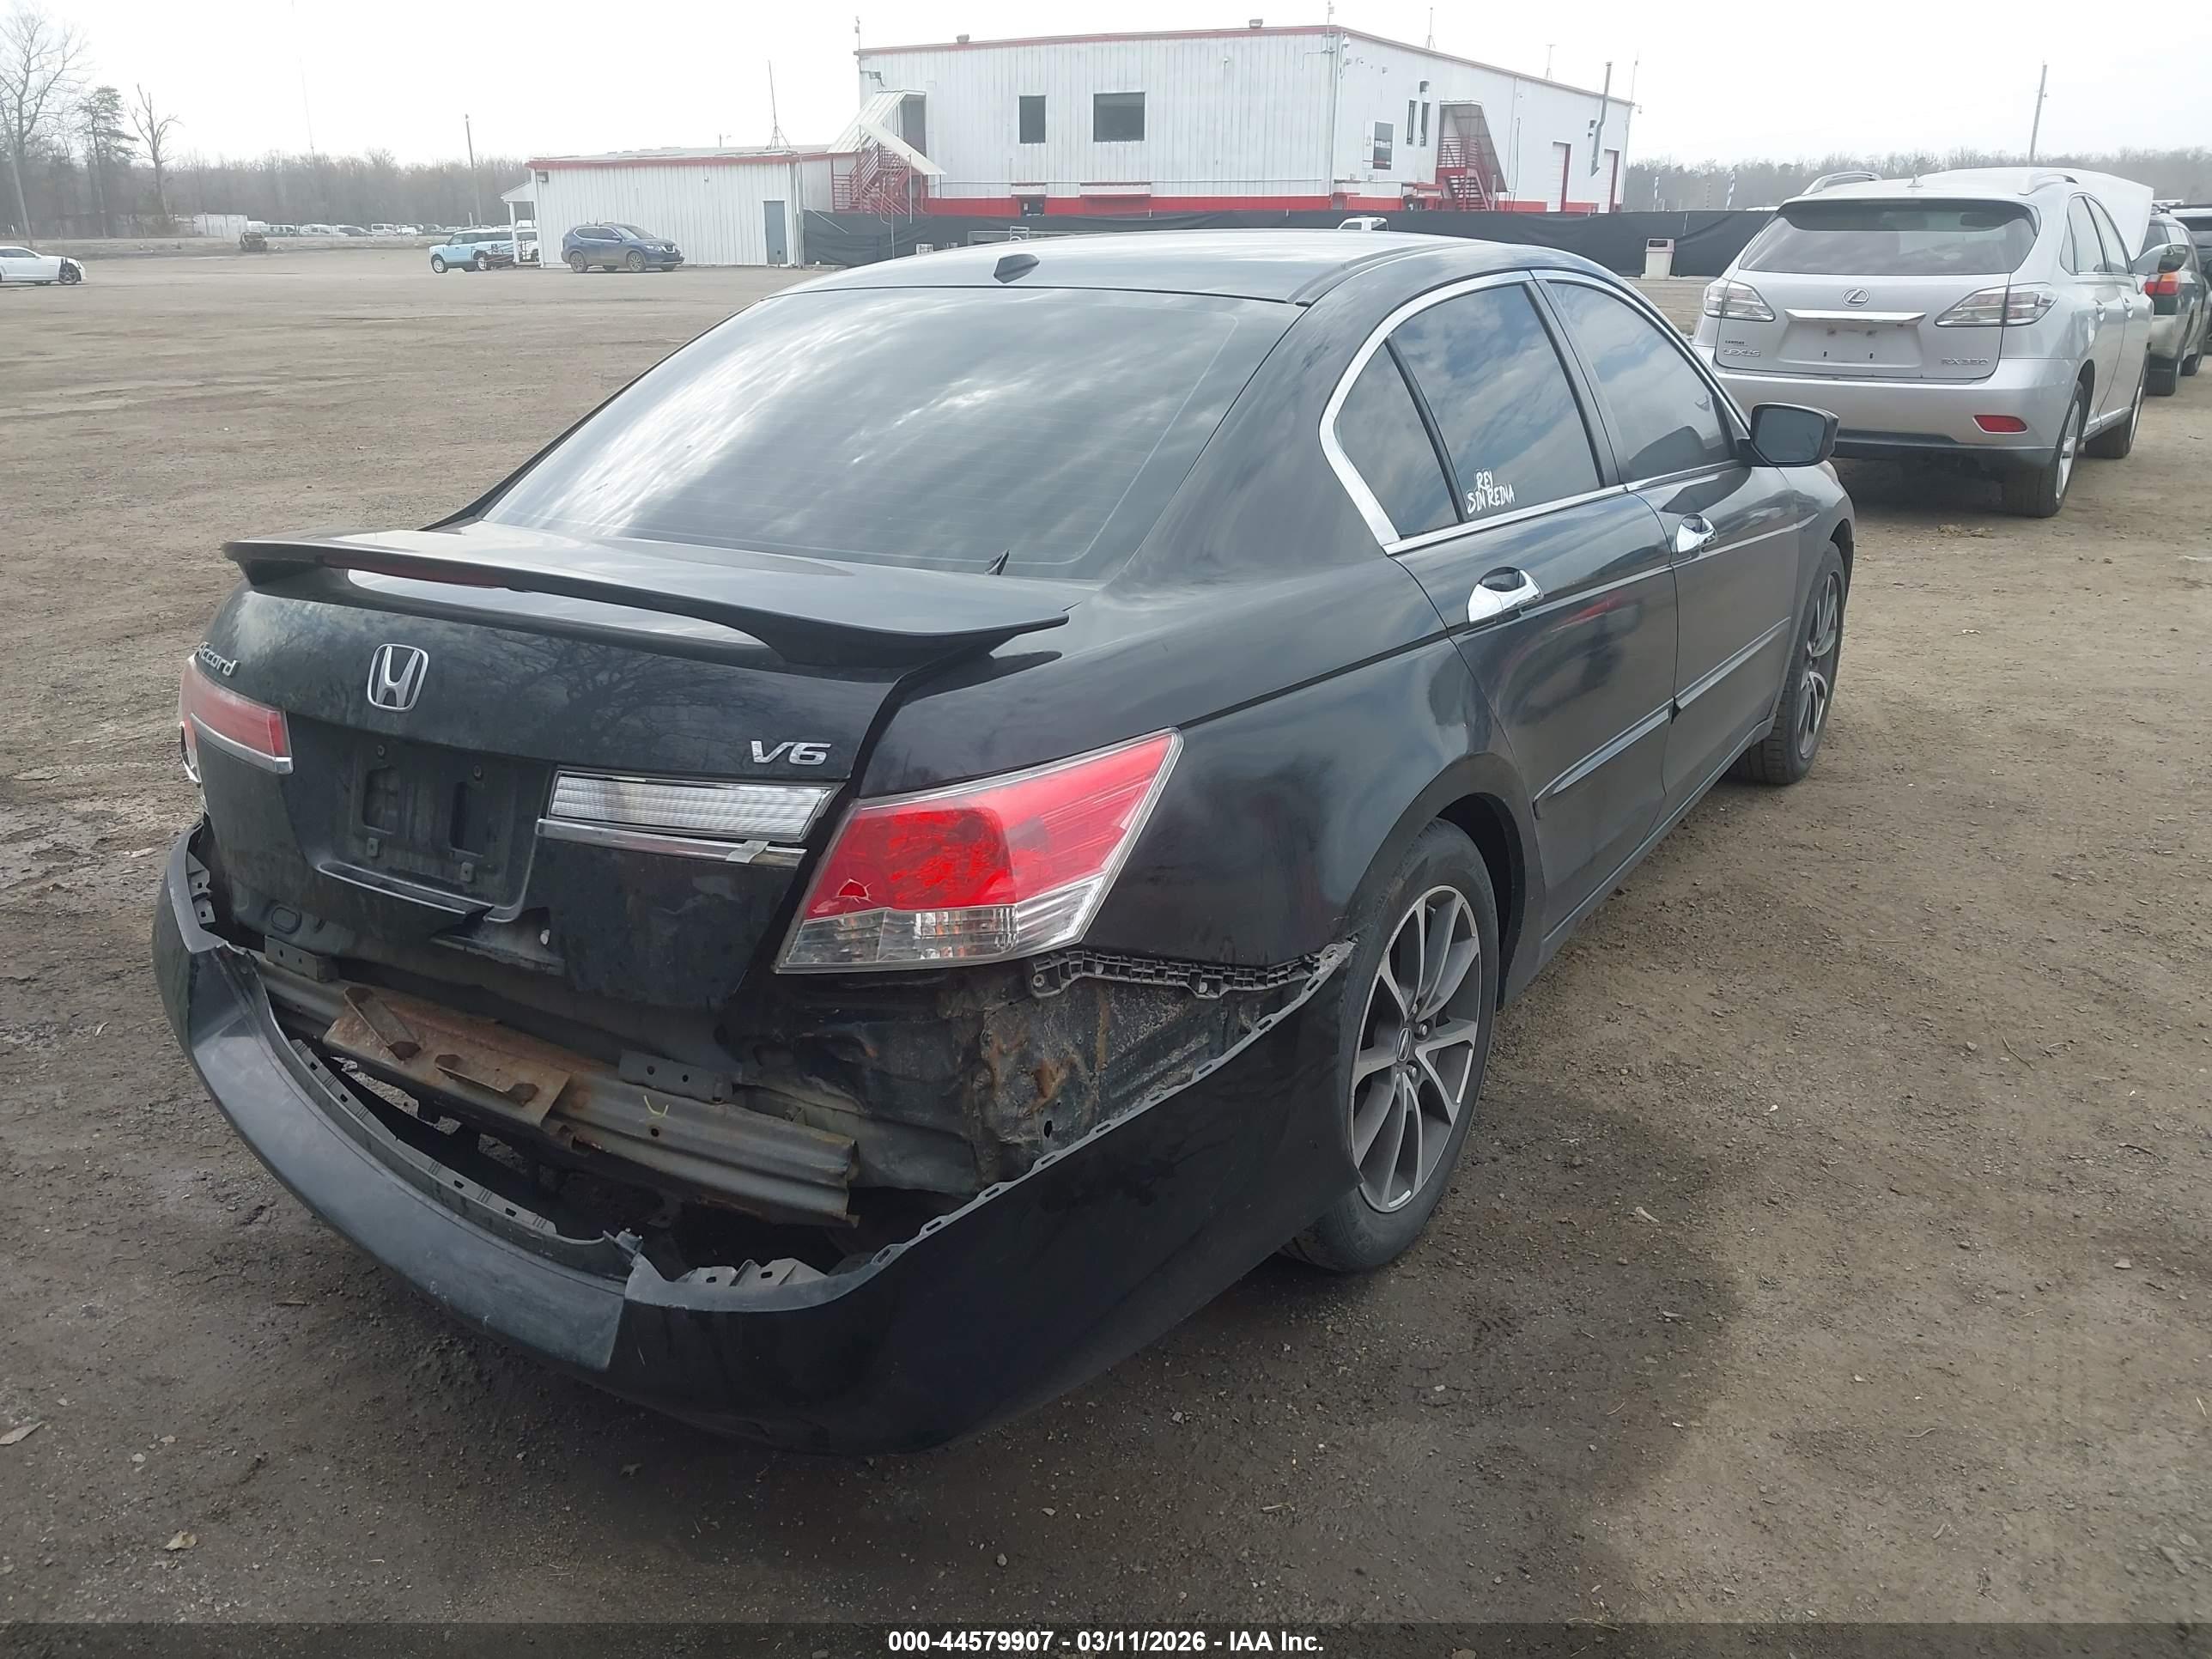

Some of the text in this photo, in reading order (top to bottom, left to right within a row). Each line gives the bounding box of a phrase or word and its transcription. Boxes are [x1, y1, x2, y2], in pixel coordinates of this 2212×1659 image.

[1723, 348, 1760, 357] LEXUS
[1475, 470, 1493, 492] REY
[195, 641, 239, 677] Accord
[750, 740, 832, 765] V6
